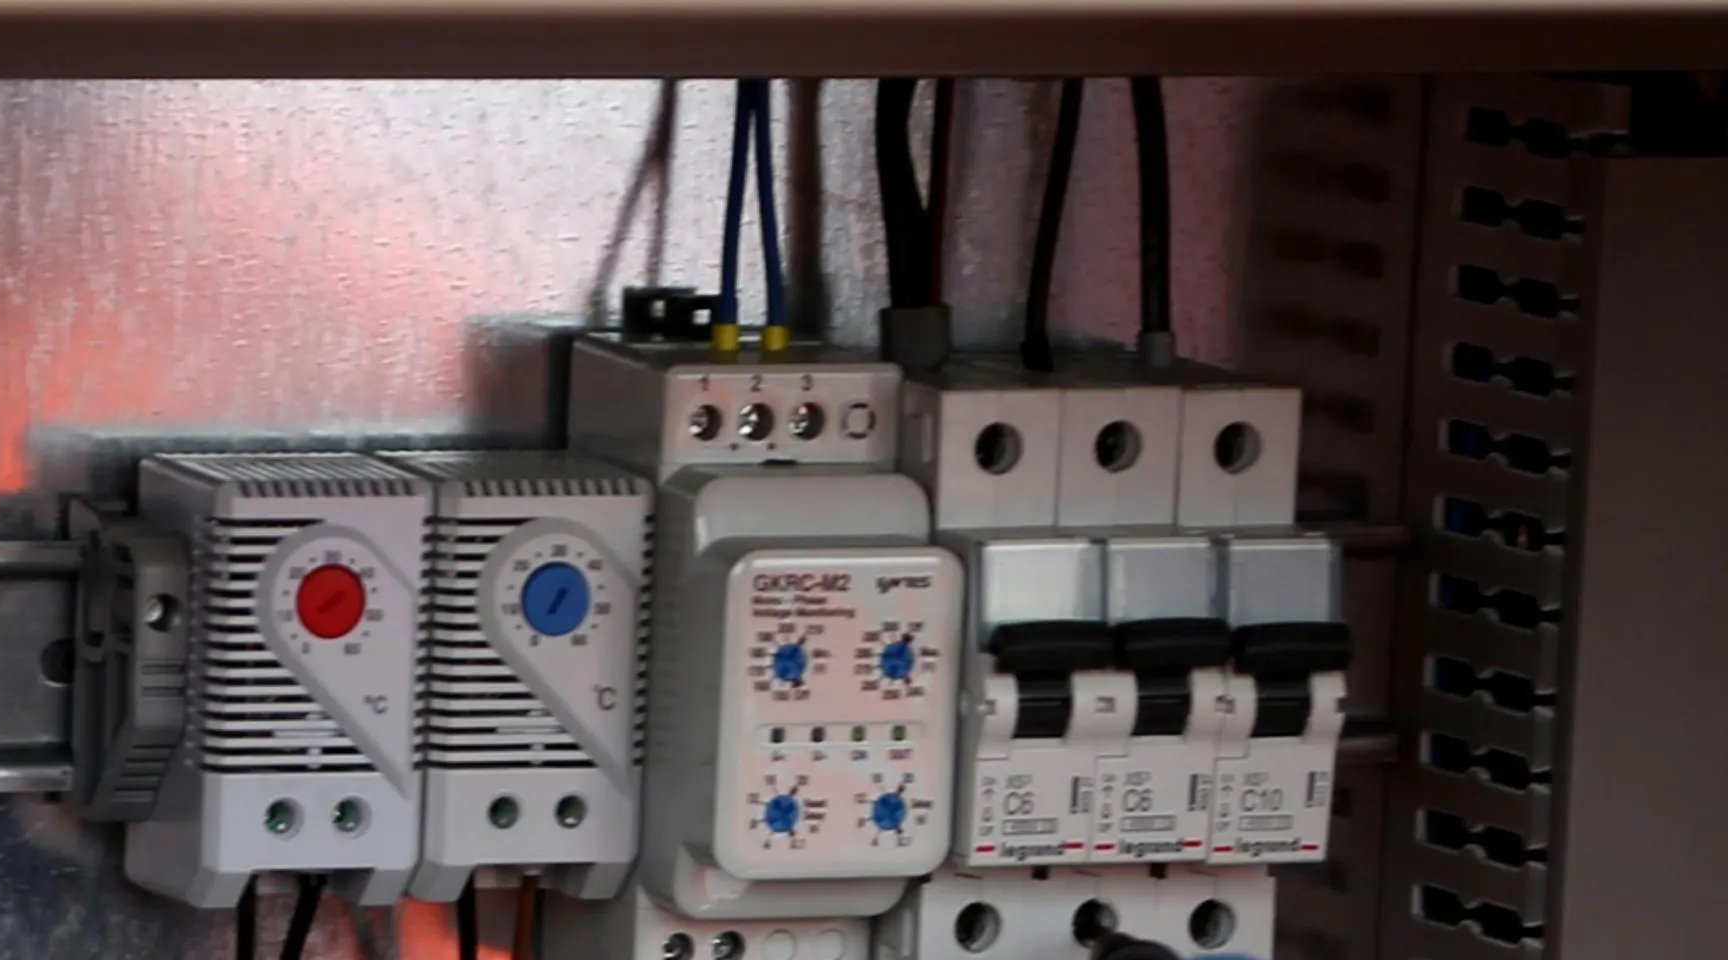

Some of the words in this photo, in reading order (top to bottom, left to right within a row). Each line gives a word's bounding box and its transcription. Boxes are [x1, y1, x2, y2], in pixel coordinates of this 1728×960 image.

[699, 373, 710, 392] 1
[751, 373, 764, 392] 2
[800, 373, 814, 392] 3
[1002, 790, 1035, 816] C6
[1121, 787, 1154, 813] C6
[1240, 787, 1284, 813] C10
